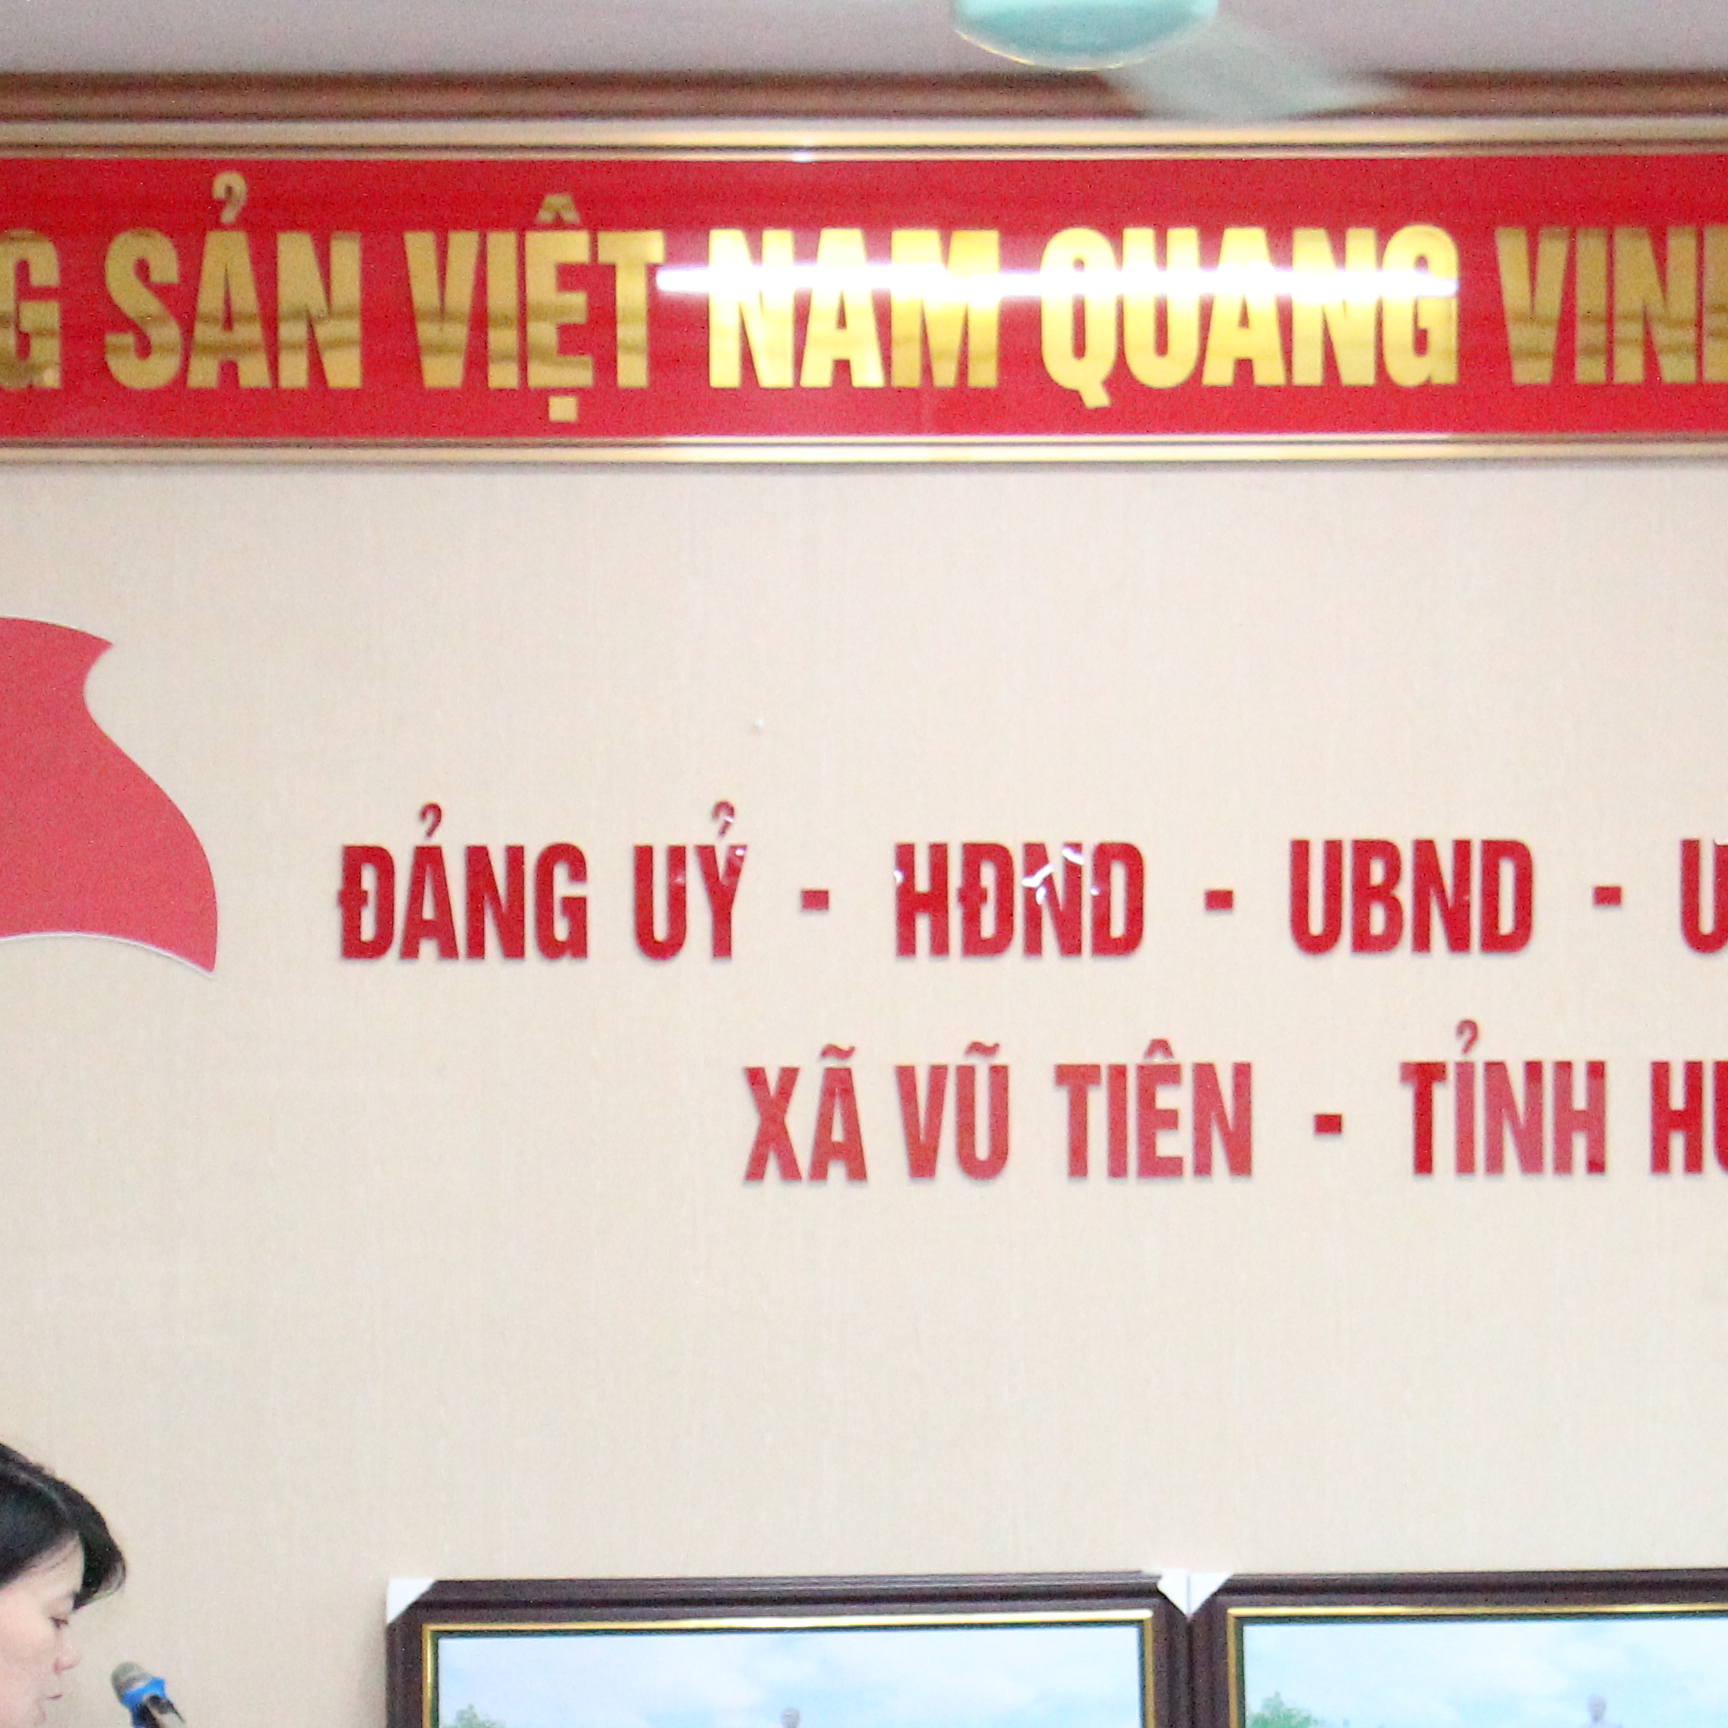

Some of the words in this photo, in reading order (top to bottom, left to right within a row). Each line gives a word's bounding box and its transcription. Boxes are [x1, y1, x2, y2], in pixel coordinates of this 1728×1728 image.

[104, 171, 364, 391] SẢN
[404, 193, 666, 423] VIỆT
[710, 226, 1002, 391] NAM
[1040, 223, 1461, 410] QUANG
[337, 802, 589, 961] ĐẢNG
[633, 801, 748, 962] UỶ
[895, 841, 1147, 958] HĐND
[1289, 837, 1535, 956] UBND
[745, 1043, 869, 1182] XÃ
[894, 1040, 1011, 1180] VŨ
[1054, 1037, 1254, 1179] TIÊN
[1399, 1019, 1608, 1176] TỈNH
